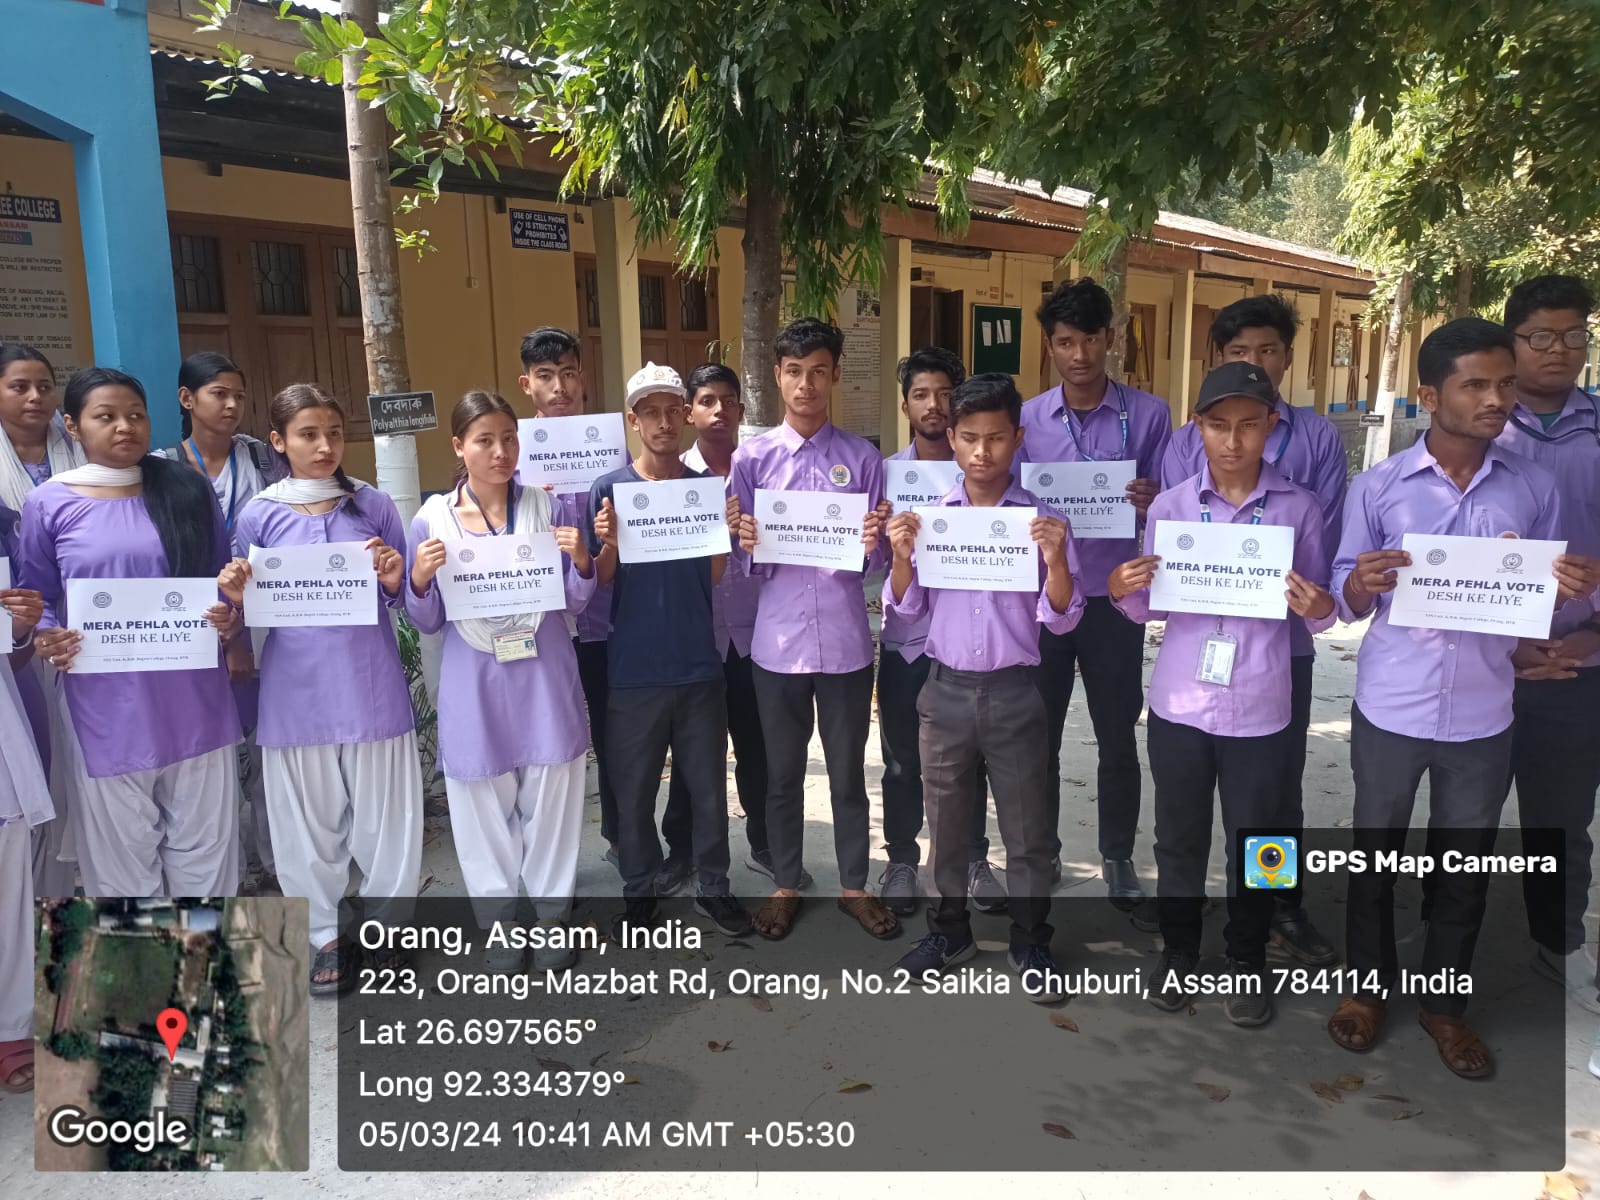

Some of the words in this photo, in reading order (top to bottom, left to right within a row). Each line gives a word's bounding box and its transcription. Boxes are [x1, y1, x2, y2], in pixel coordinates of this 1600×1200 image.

[0, 196, 13, 214] EE
[14, 198, 56, 218] COLLEGE
[512, 211, 524, 220] USE
[533, 213, 547, 222] CELL
[548, 215, 566, 224] PHONE
[532, 222, 557, 232] STRICTLY
[525, 230, 558, 240] PROHIBITED
[373, 415, 409, 432] Polyalthia
[529, 452, 557, 462] MERA
[560, 450, 591, 459] PEHLA
[594, 448, 620, 456] VOTE
[544, 462, 568, 472] DESH
[571, 462, 584, 470] KE
[587, 459, 608, 468] LIYE
[1074, 507, 1087, 515] KE
[1091, 506, 1114, 515] LIYE
[628, 519, 655, 527] MERA
[659, 516, 692, 525] PEHLA
[642, 529, 666, 538] DESH
[670, 527, 683, 536] KE
[686, 524, 708, 534] LIYE
[833, 527, 858, 535] VOTE
[823, 536, 844, 545] LIYE
[961, 545, 995, 553] PEHLA
[941, 556, 968, 564] DESH
[972, 557, 986, 565] KE
[990, 557, 1014, 566] LIYE
[454, 573, 485, 583] MERA
[488, 570, 523, 580] PEHLA
[526, 567, 554, 576] VOTE
[1166, 562, 1200, 572] MERA
[1205, 565, 1244, 575] PEHLA
[1248, 568, 1281, 577] VOTE
[257, 581, 290, 589] MERA
[470, 583, 497, 593] DESH
[500, 582, 515, 590] KE
[518, 579, 541, 589] LIYE
[1181, 576, 1211, 586] DESH
[1216, 578, 1232, 587] KE
[1236, 579, 1263, 590] LIYE
[1412, 578, 1450, 587] MERA
[1456, 580, 1502, 590] PEHLA
[1506, 582, 1545, 593] VOTE
[273, 592, 303, 601] DESH
[308, 592, 322, 601] KE
[327, 591, 352, 600] LIYE
[1427, 591, 1462, 601] DESH
[1467, 594, 1486, 604] KE
[1490, 594, 1522, 606] LIYE
[83, 621, 122, 630] MERA
[126, 621, 169, 629] PEHLA
[101, 634, 135, 644] DESH
[140, 633, 157, 643] KE
[162, 632, 191, 642] LIYE
